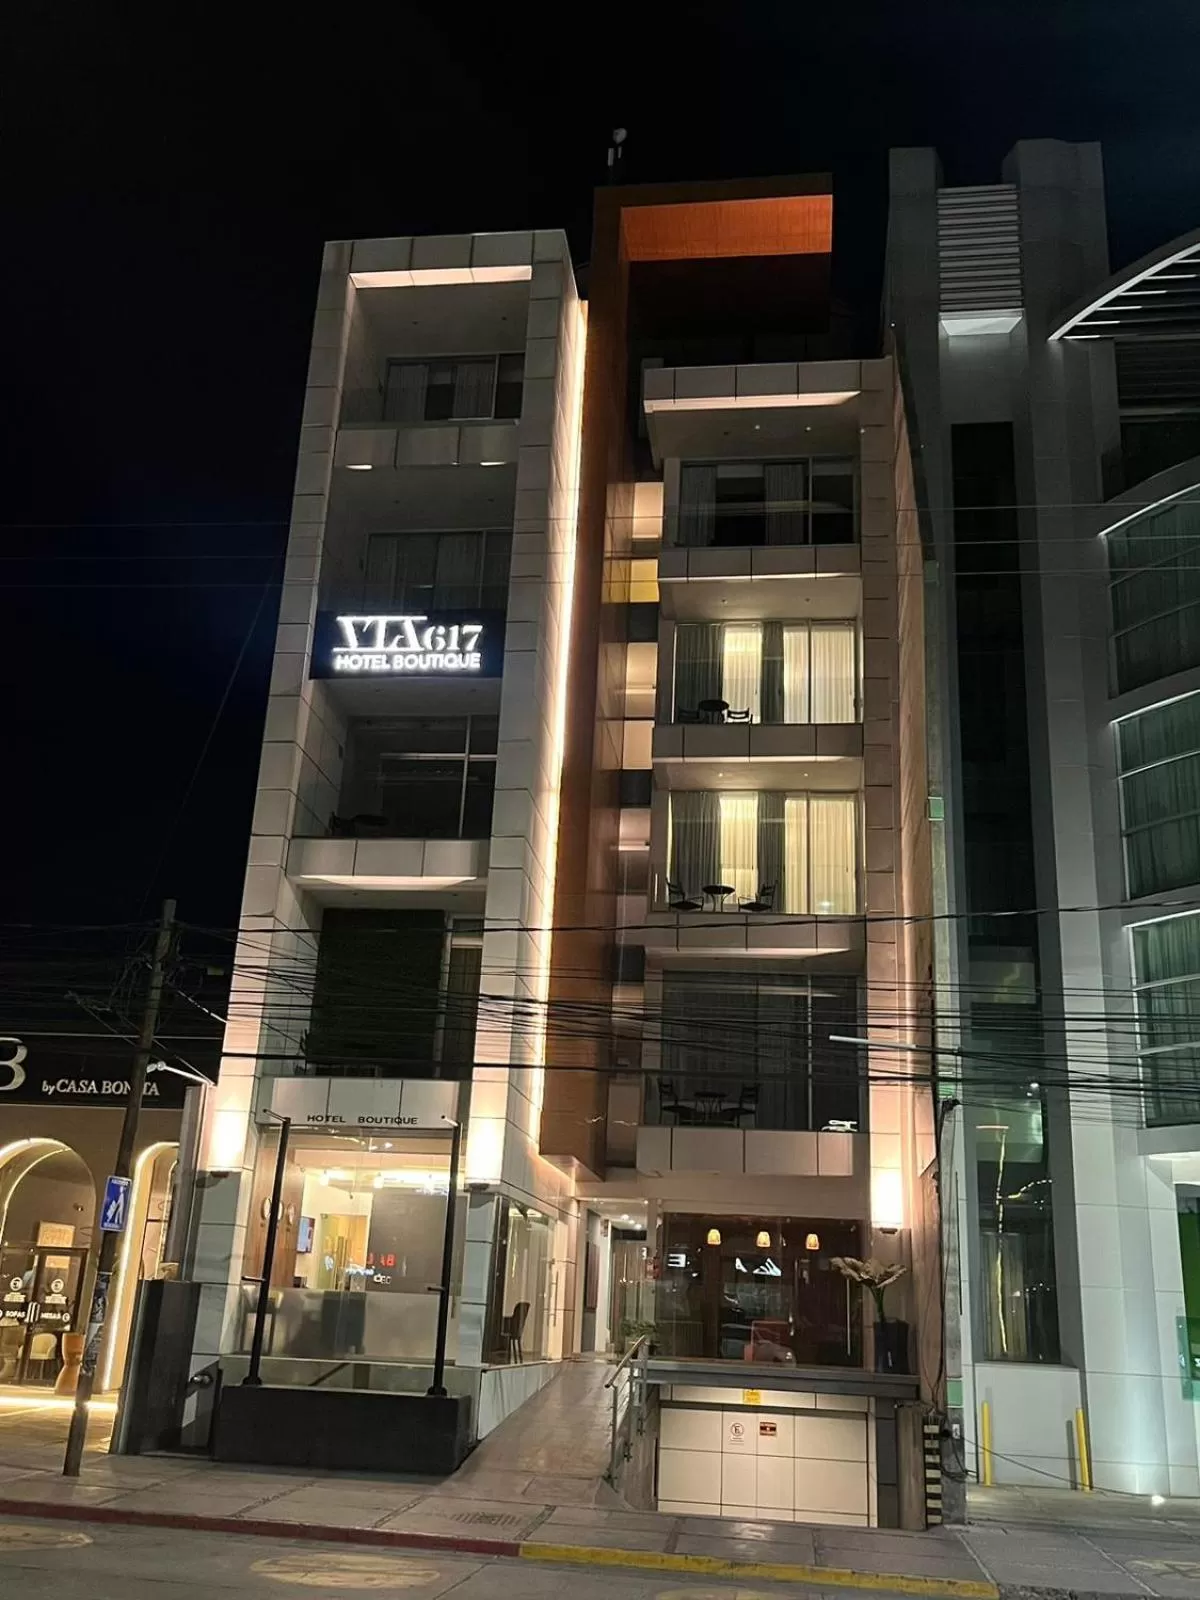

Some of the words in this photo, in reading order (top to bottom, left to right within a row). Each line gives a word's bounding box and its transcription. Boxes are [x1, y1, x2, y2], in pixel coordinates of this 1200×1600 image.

[335, 654, 391, 670] HOTEL
[393, 653, 482, 669] BOUTIQUE
[56, 1079, 99, 1094] CASA
[307, 1114, 347, 1123] HOTEL
[357, 1116, 419, 1125] BOUTIQUE
